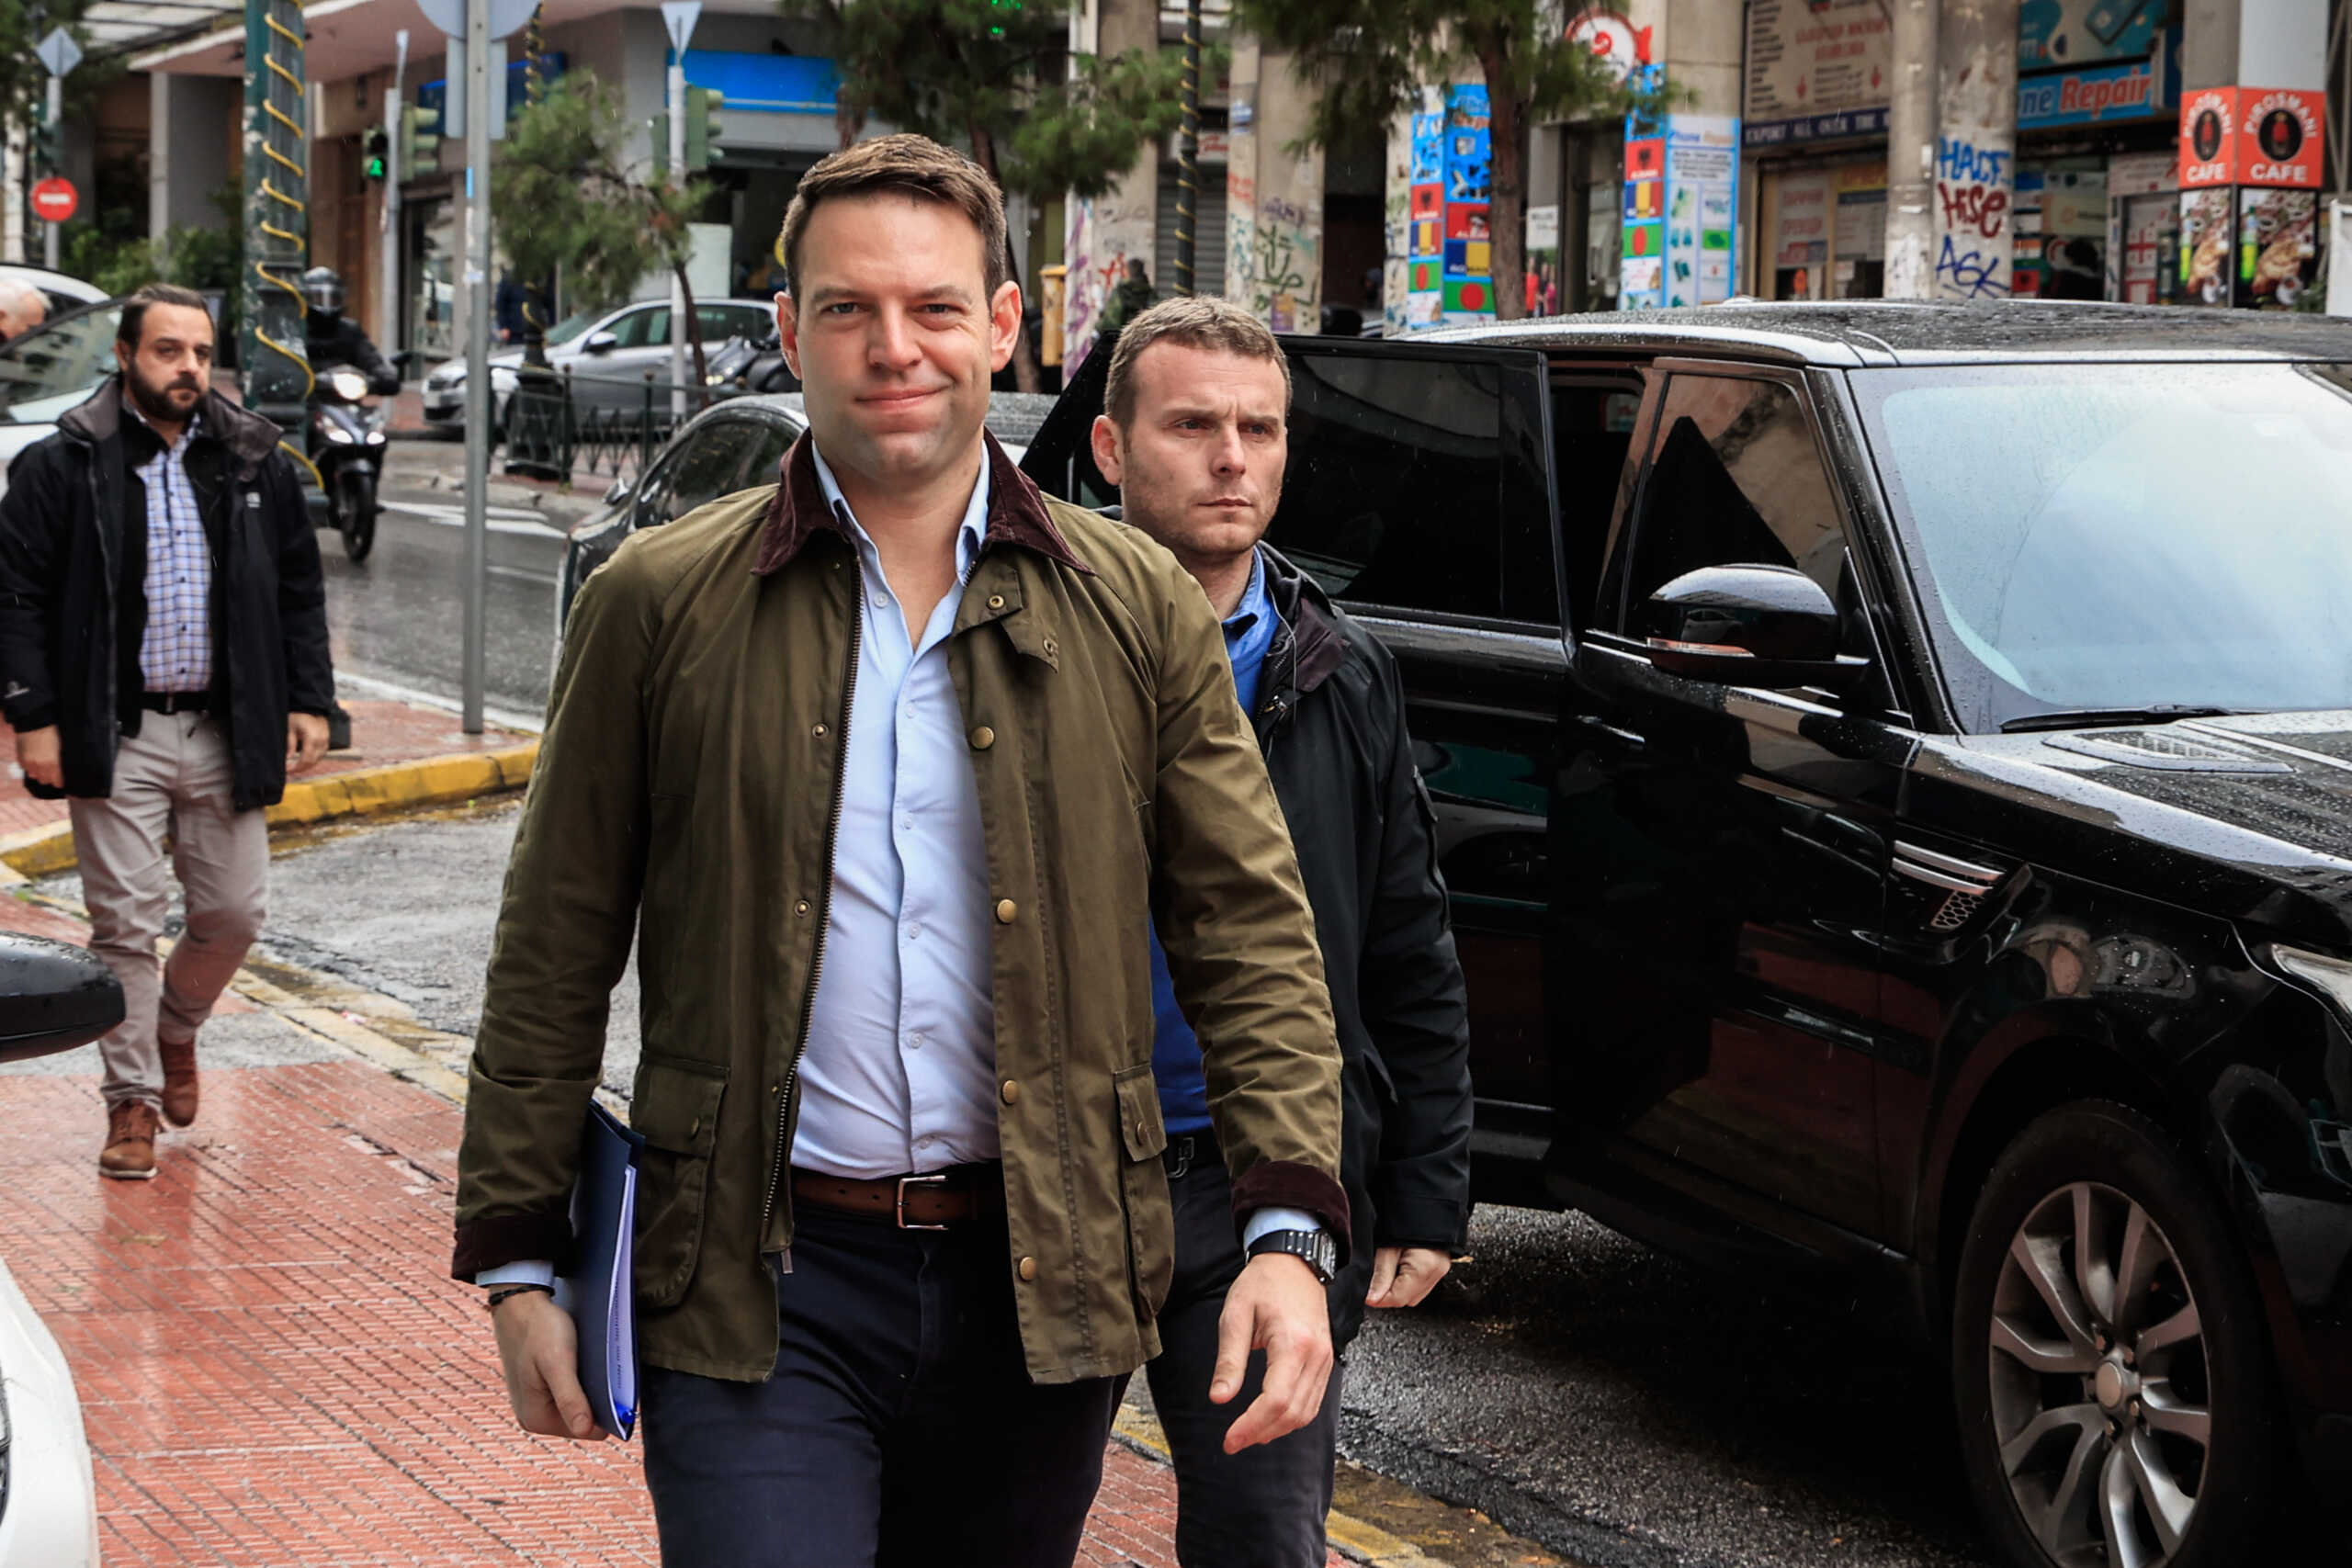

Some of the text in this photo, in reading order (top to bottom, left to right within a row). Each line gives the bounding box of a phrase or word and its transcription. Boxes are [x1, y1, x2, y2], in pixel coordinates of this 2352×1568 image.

[2060, 67, 2152, 119] Repair
[2244, 93, 2317, 137] PIROSMANI
[2187, 164, 2225, 182] CAFE
[2251, 164, 2307, 182] CAFE
